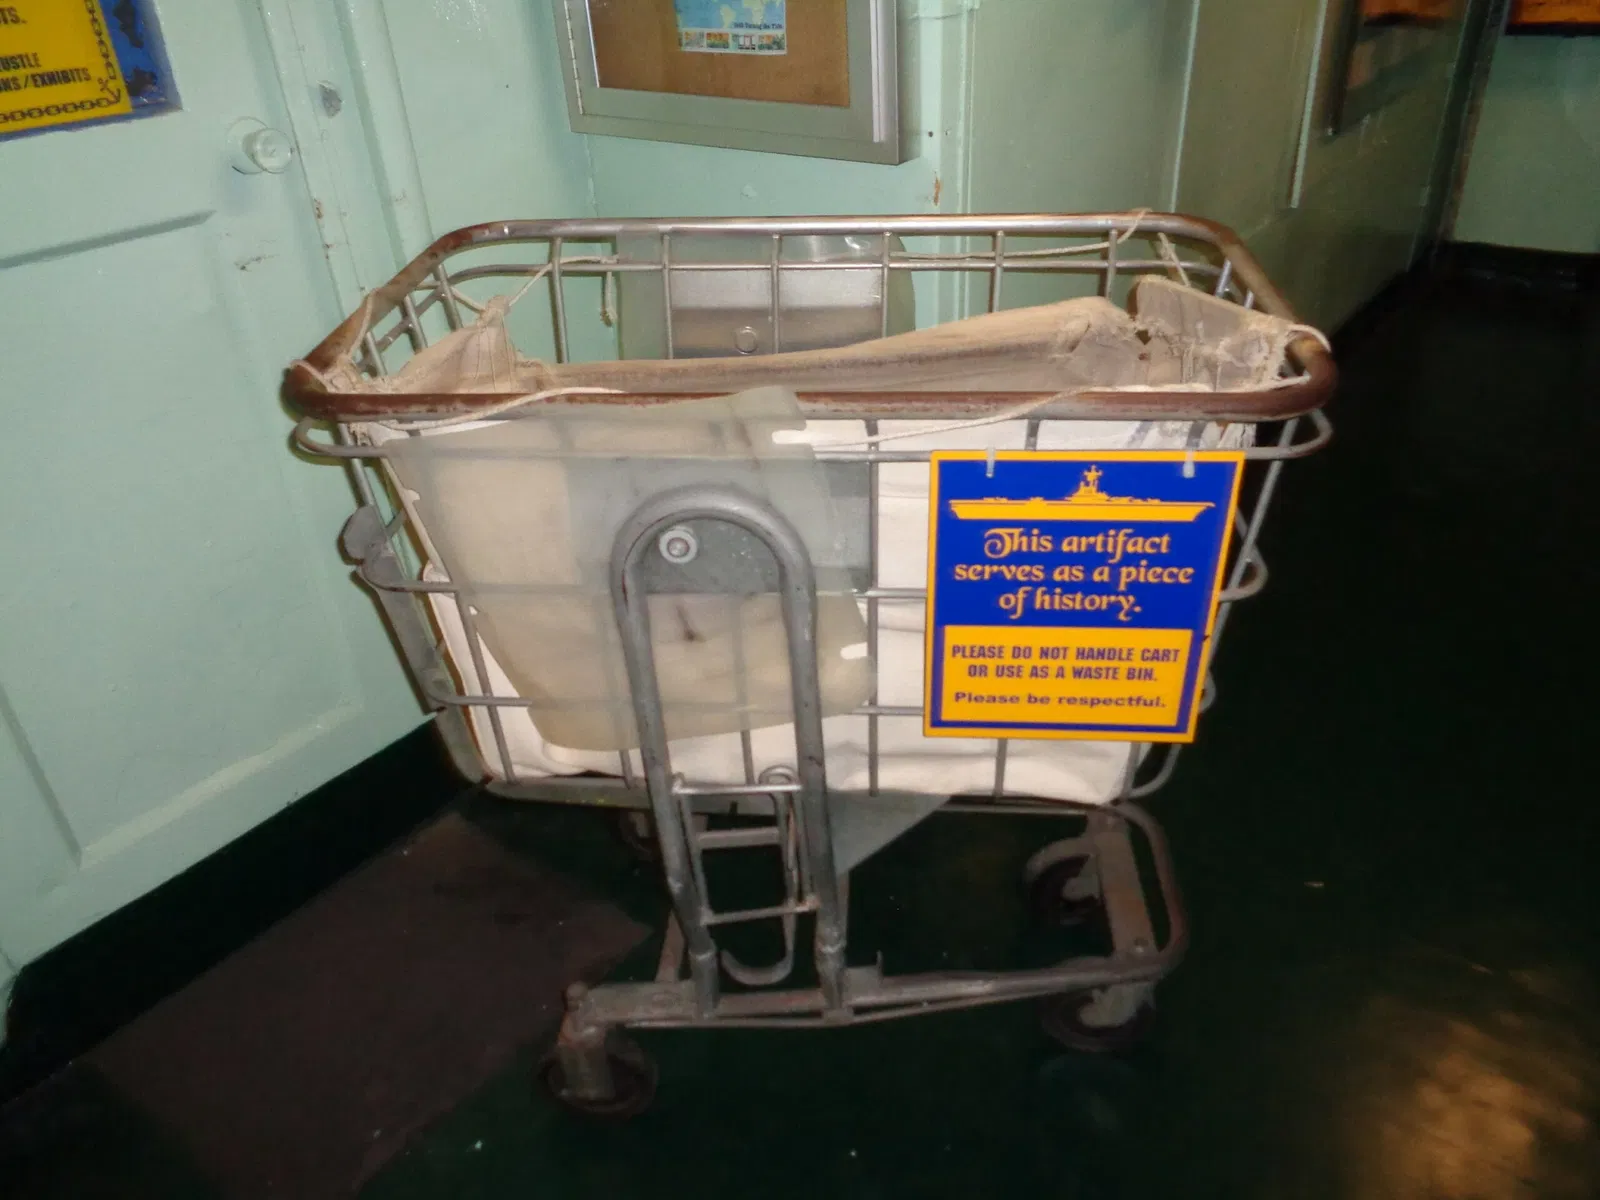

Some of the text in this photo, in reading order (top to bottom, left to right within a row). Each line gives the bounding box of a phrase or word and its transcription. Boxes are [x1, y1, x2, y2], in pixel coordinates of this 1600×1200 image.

[0, 6, 28, 24] TS.
[0, 52, 41, 71] USTLE
[0, 67, 91, 92] NS/EXHIBITS
[984, 528, 1171, 564] This artifact
[954, 560, 1195, 591] serves as a piece
[999, 586, 1142, 621] of history.
[952, 645, 1181, 663] PLEASE DO NOT HANDLE CART
[967, 664, 1158, 681] OR USE AS A WASTE BIN.
[954, 691, 1167, 708] Please be respectful.
